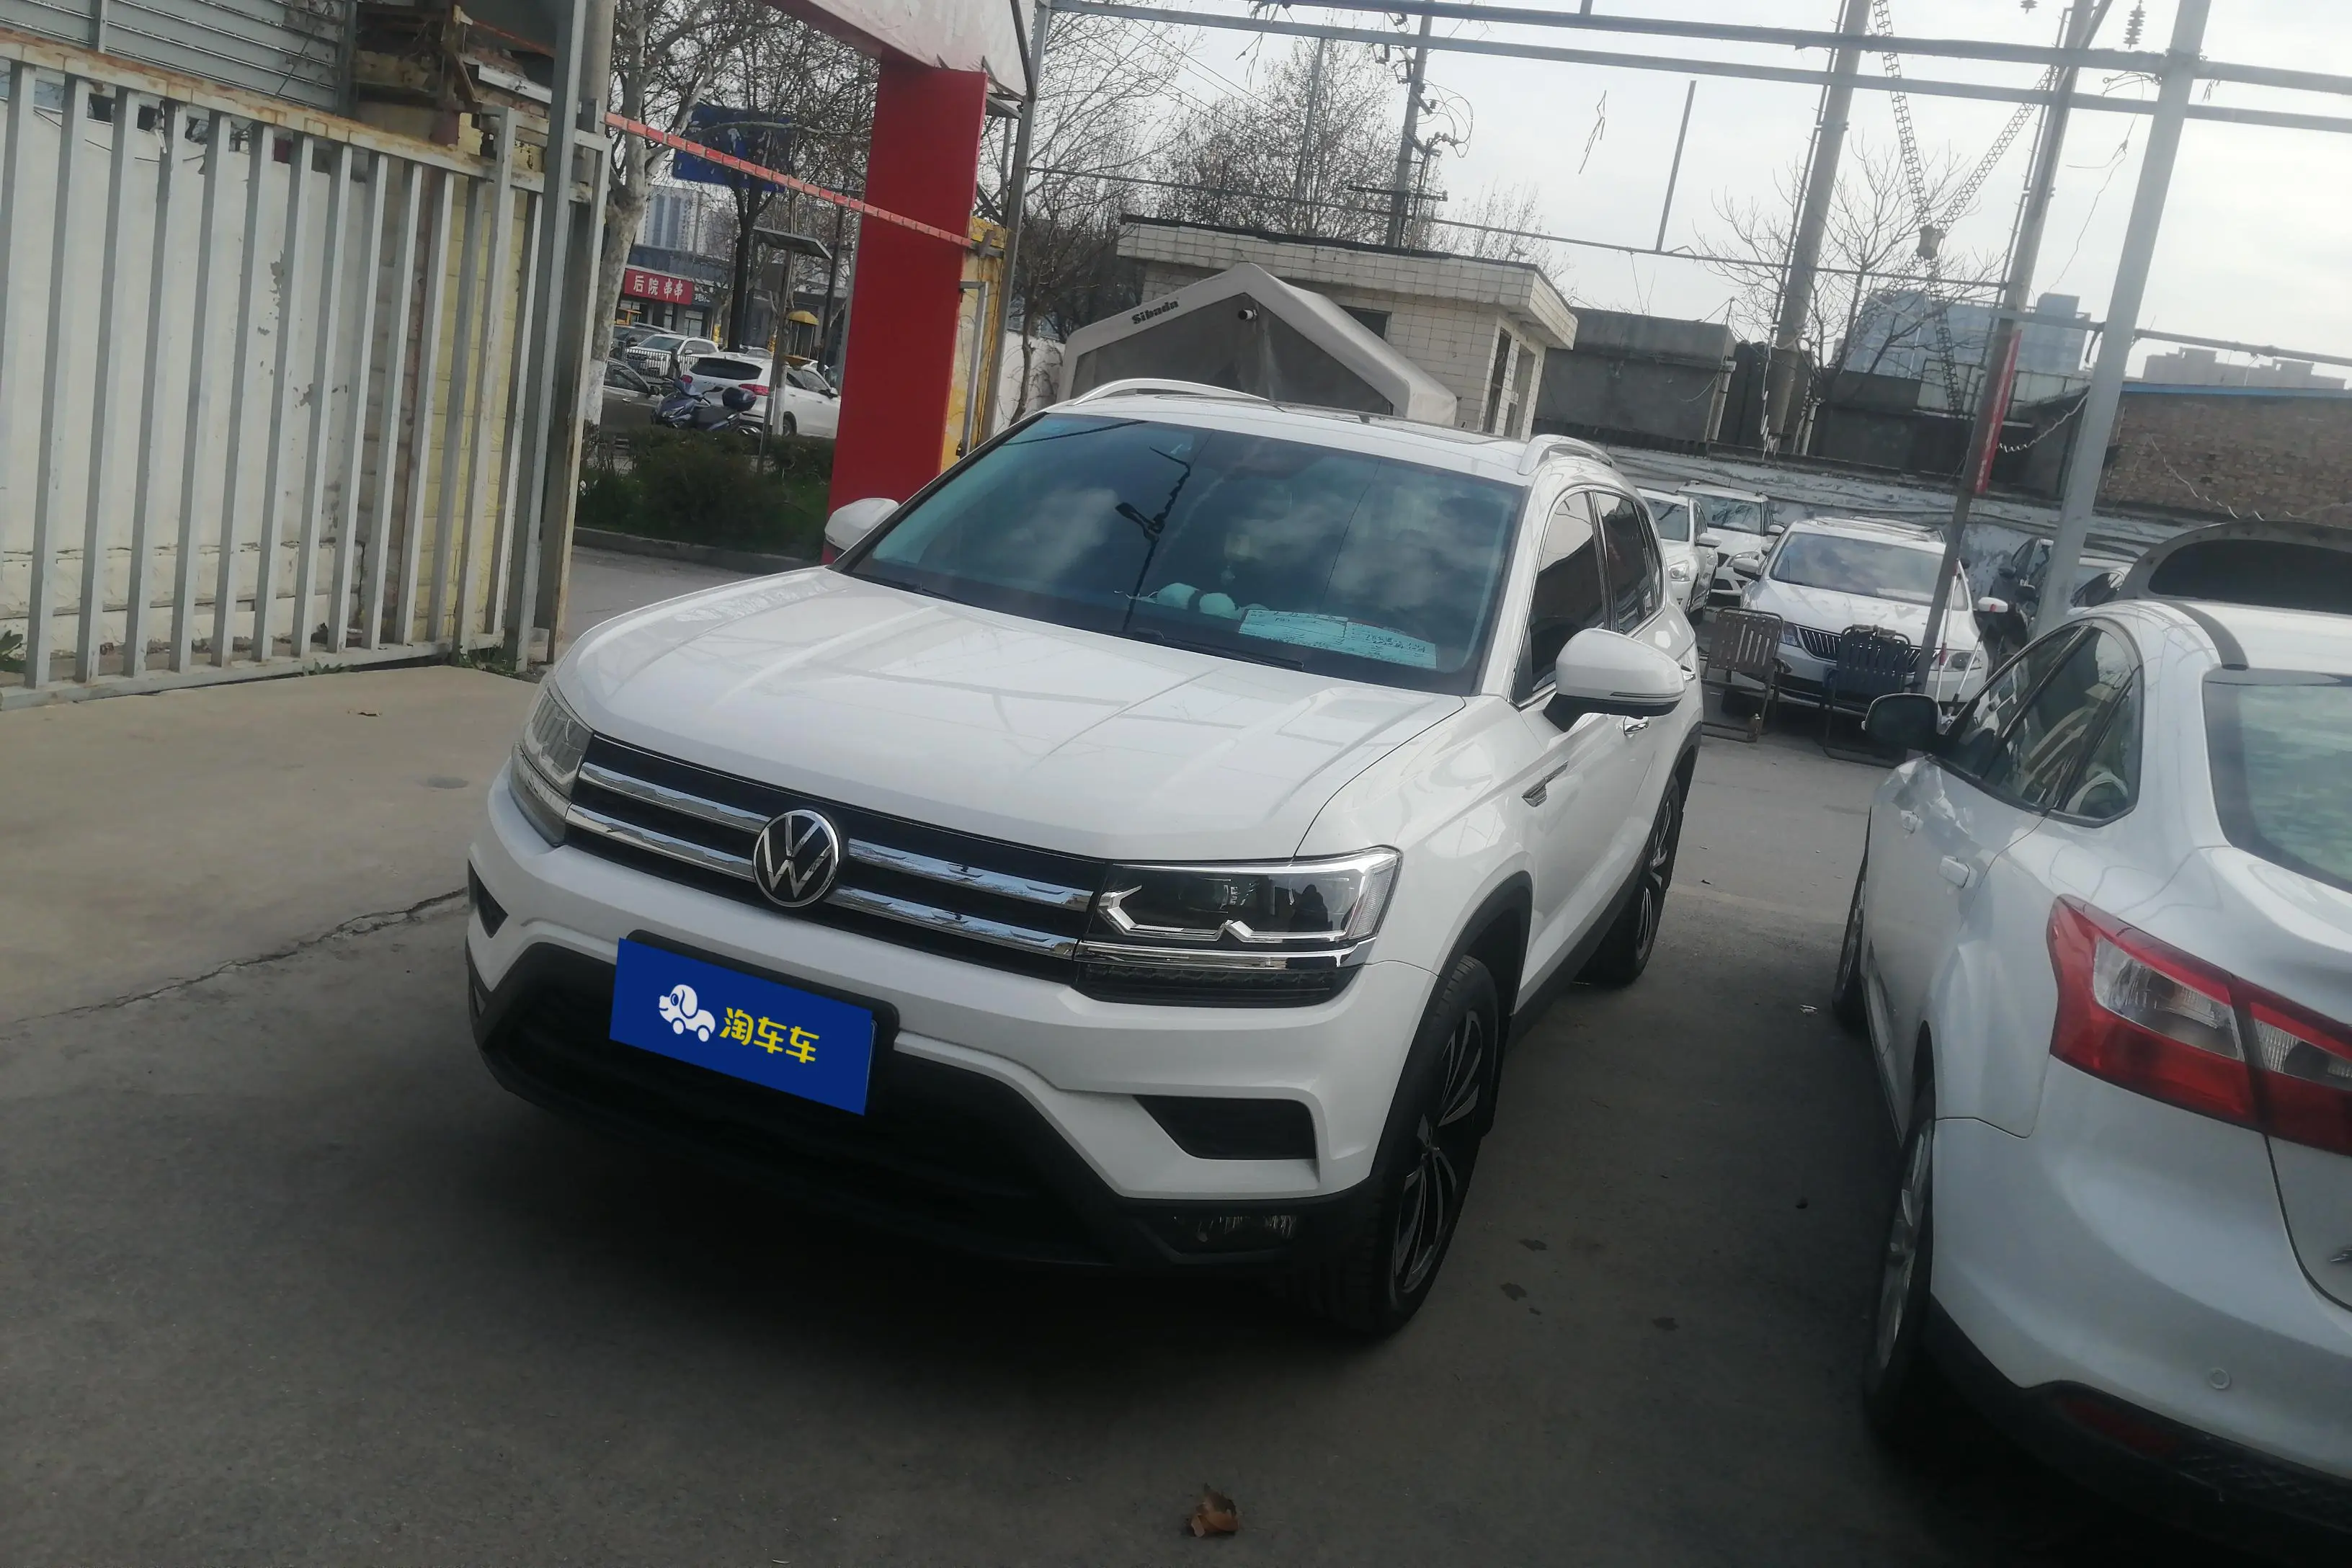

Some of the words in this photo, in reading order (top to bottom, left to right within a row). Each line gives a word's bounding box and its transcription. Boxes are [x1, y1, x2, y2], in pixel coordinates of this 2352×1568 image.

[633, 275, 684, 302] 后院串串
[760, 811, 836, 900] VW
